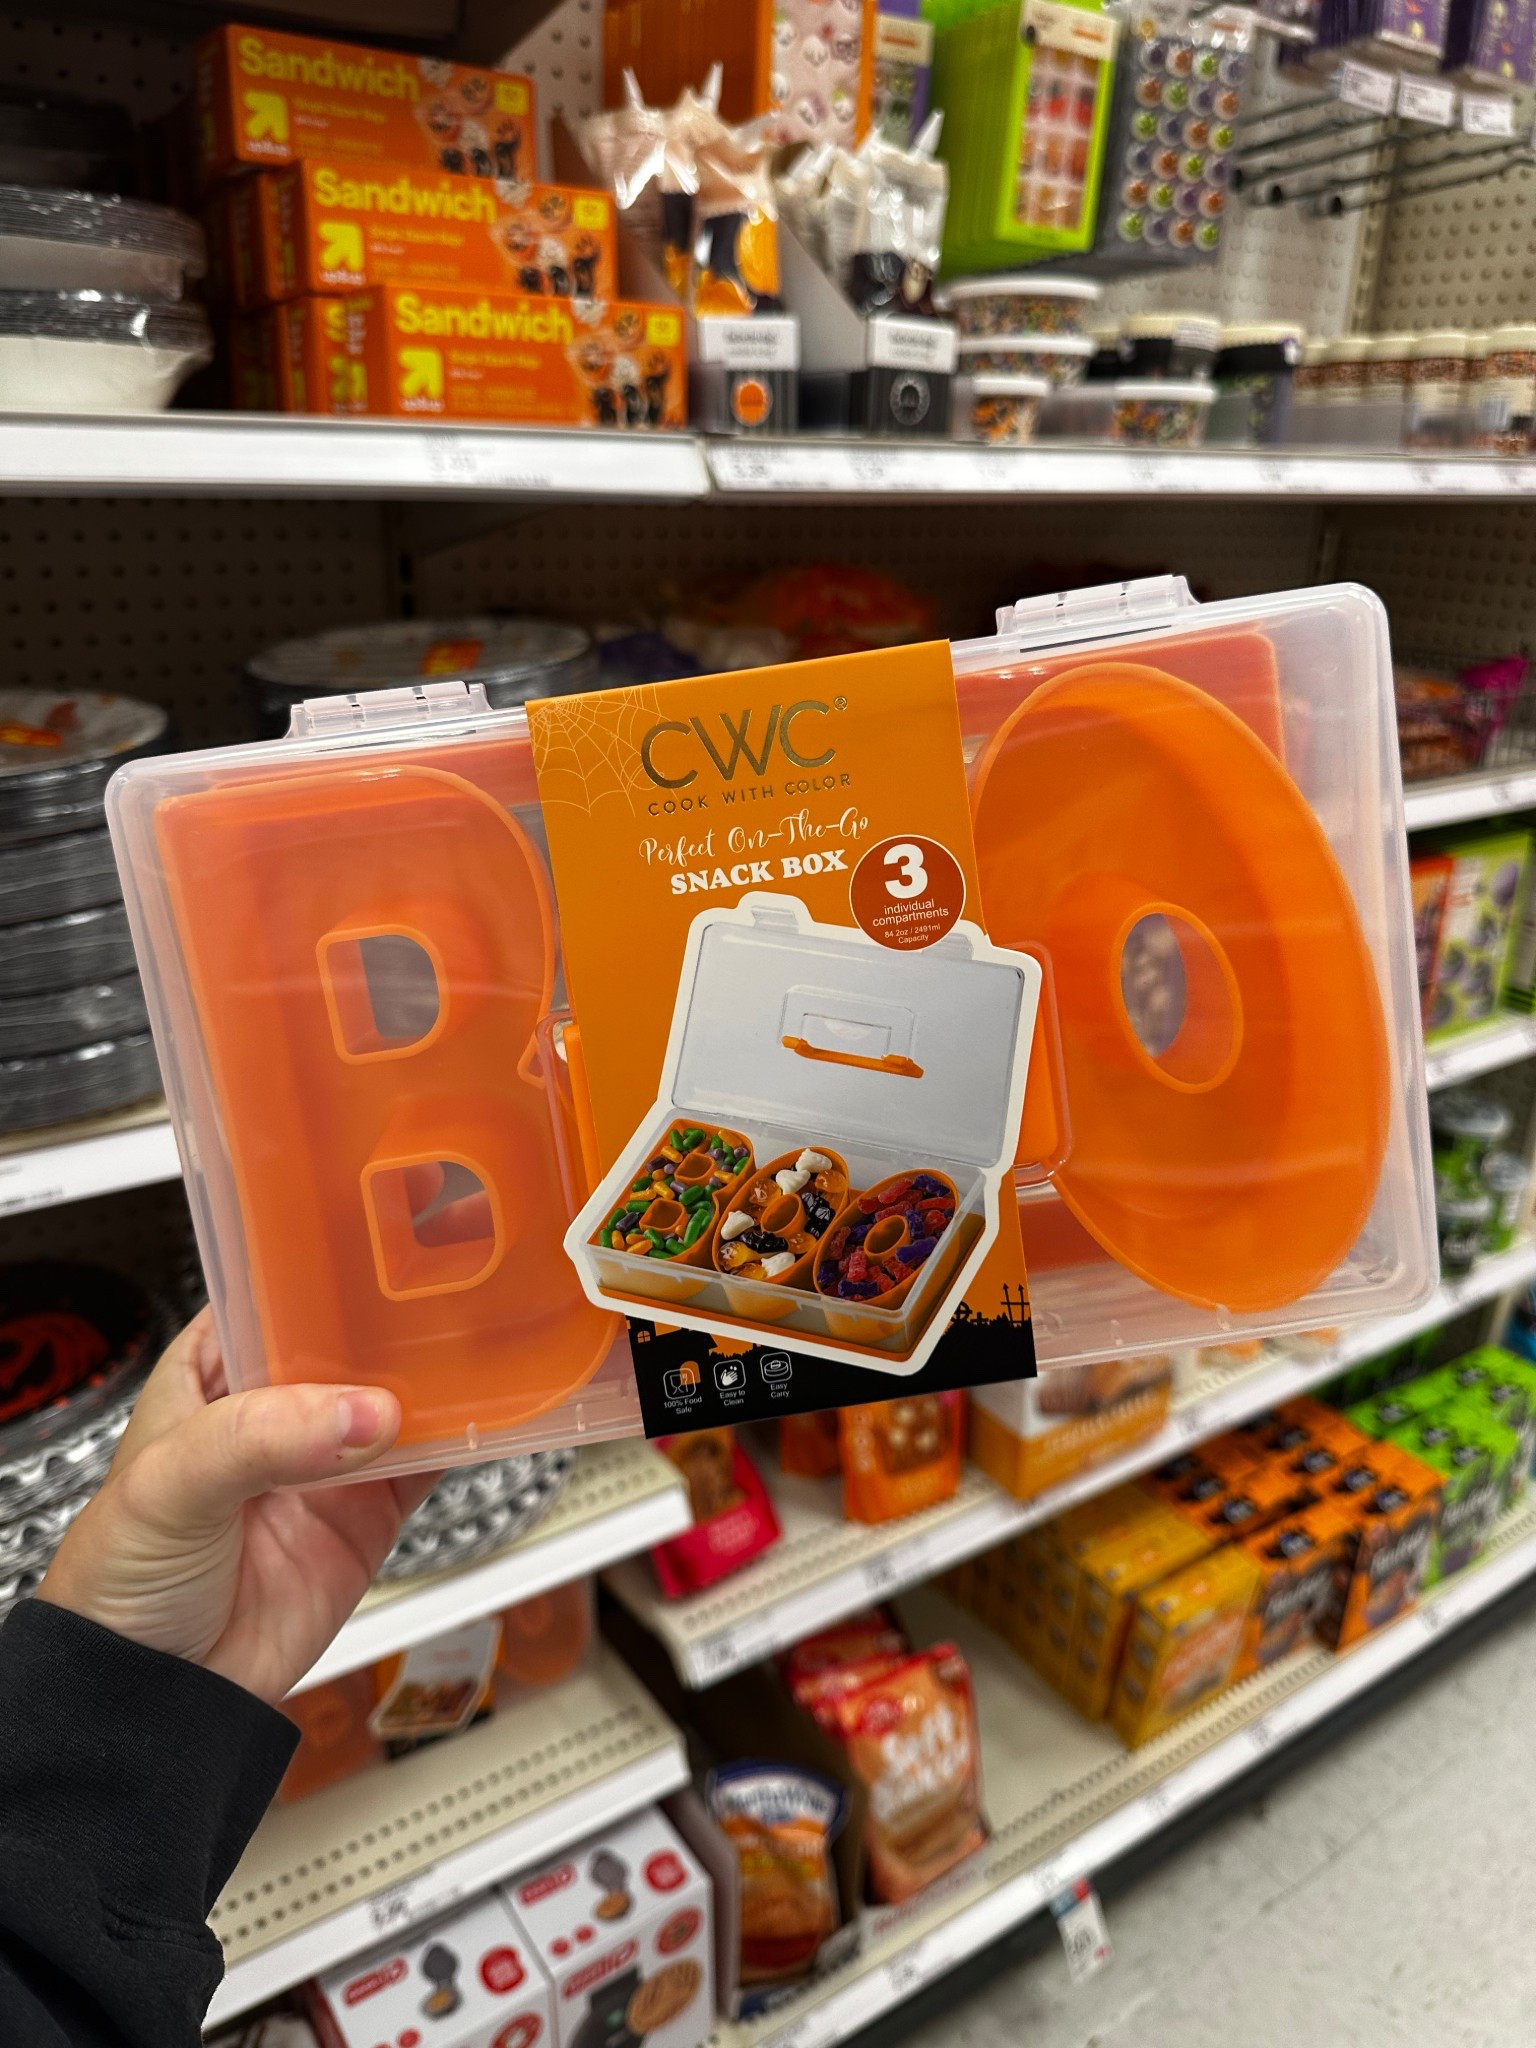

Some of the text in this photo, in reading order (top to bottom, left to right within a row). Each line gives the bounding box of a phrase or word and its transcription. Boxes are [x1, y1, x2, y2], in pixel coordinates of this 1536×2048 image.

[239, 36, 420, 100] Sandwich
[314, 168, 497, 223] Sandwich
[395, 293, 574, 344] Sandwich
[648, 773, 851, 816] COOK WITH COLOR
[639, 828, 715, 867] Perfect
[671, 849, 849, 895] SNACK BOX
[883, 843, 929, 899] 3
[884, 898, 935, 915] individual
[872, 907, 949, 927] compartments
[898, 934, 929, 945] Capacity
[719, 1391, 737, 1400] Easy
[770, 1383, 788, 1392] Easy
[770, 1390, 790, 1399] Carry
[663, 1396, 703, 1408] 100% Food
[675, 1406, 692, 1415] Safe
[723, 1398, 744, 1407] Clean
